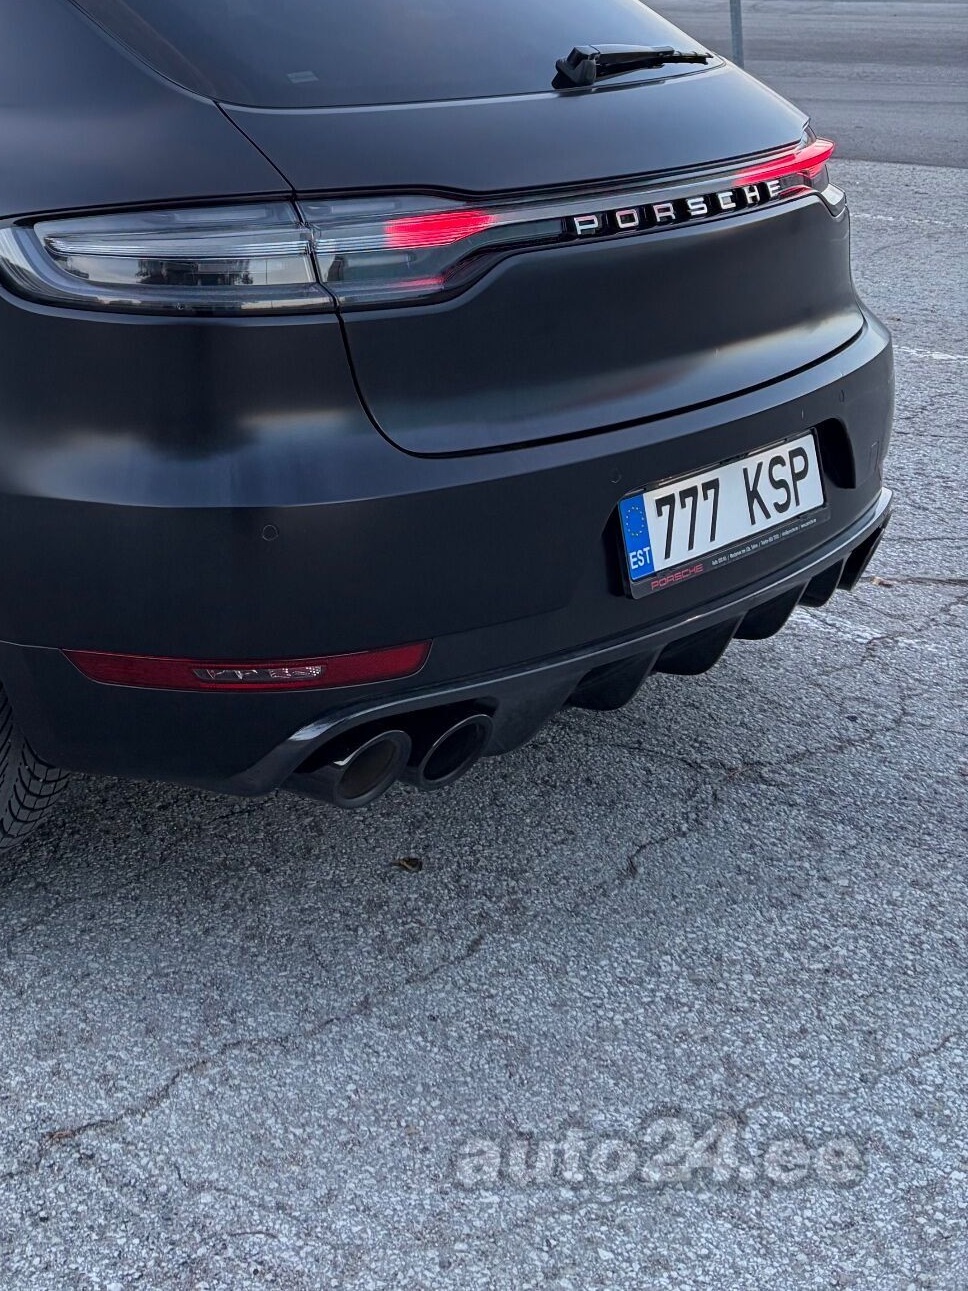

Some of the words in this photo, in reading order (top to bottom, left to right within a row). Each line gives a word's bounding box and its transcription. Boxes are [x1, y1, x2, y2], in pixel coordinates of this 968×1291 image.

[573, 179, 781, 236] PORSCHE
[654, 477, 720, 560] 777
[742, 446, 809, 526] KSP
[629, 545, 651, 570] EST
[650, 563, 704, 591] PORSCHE
